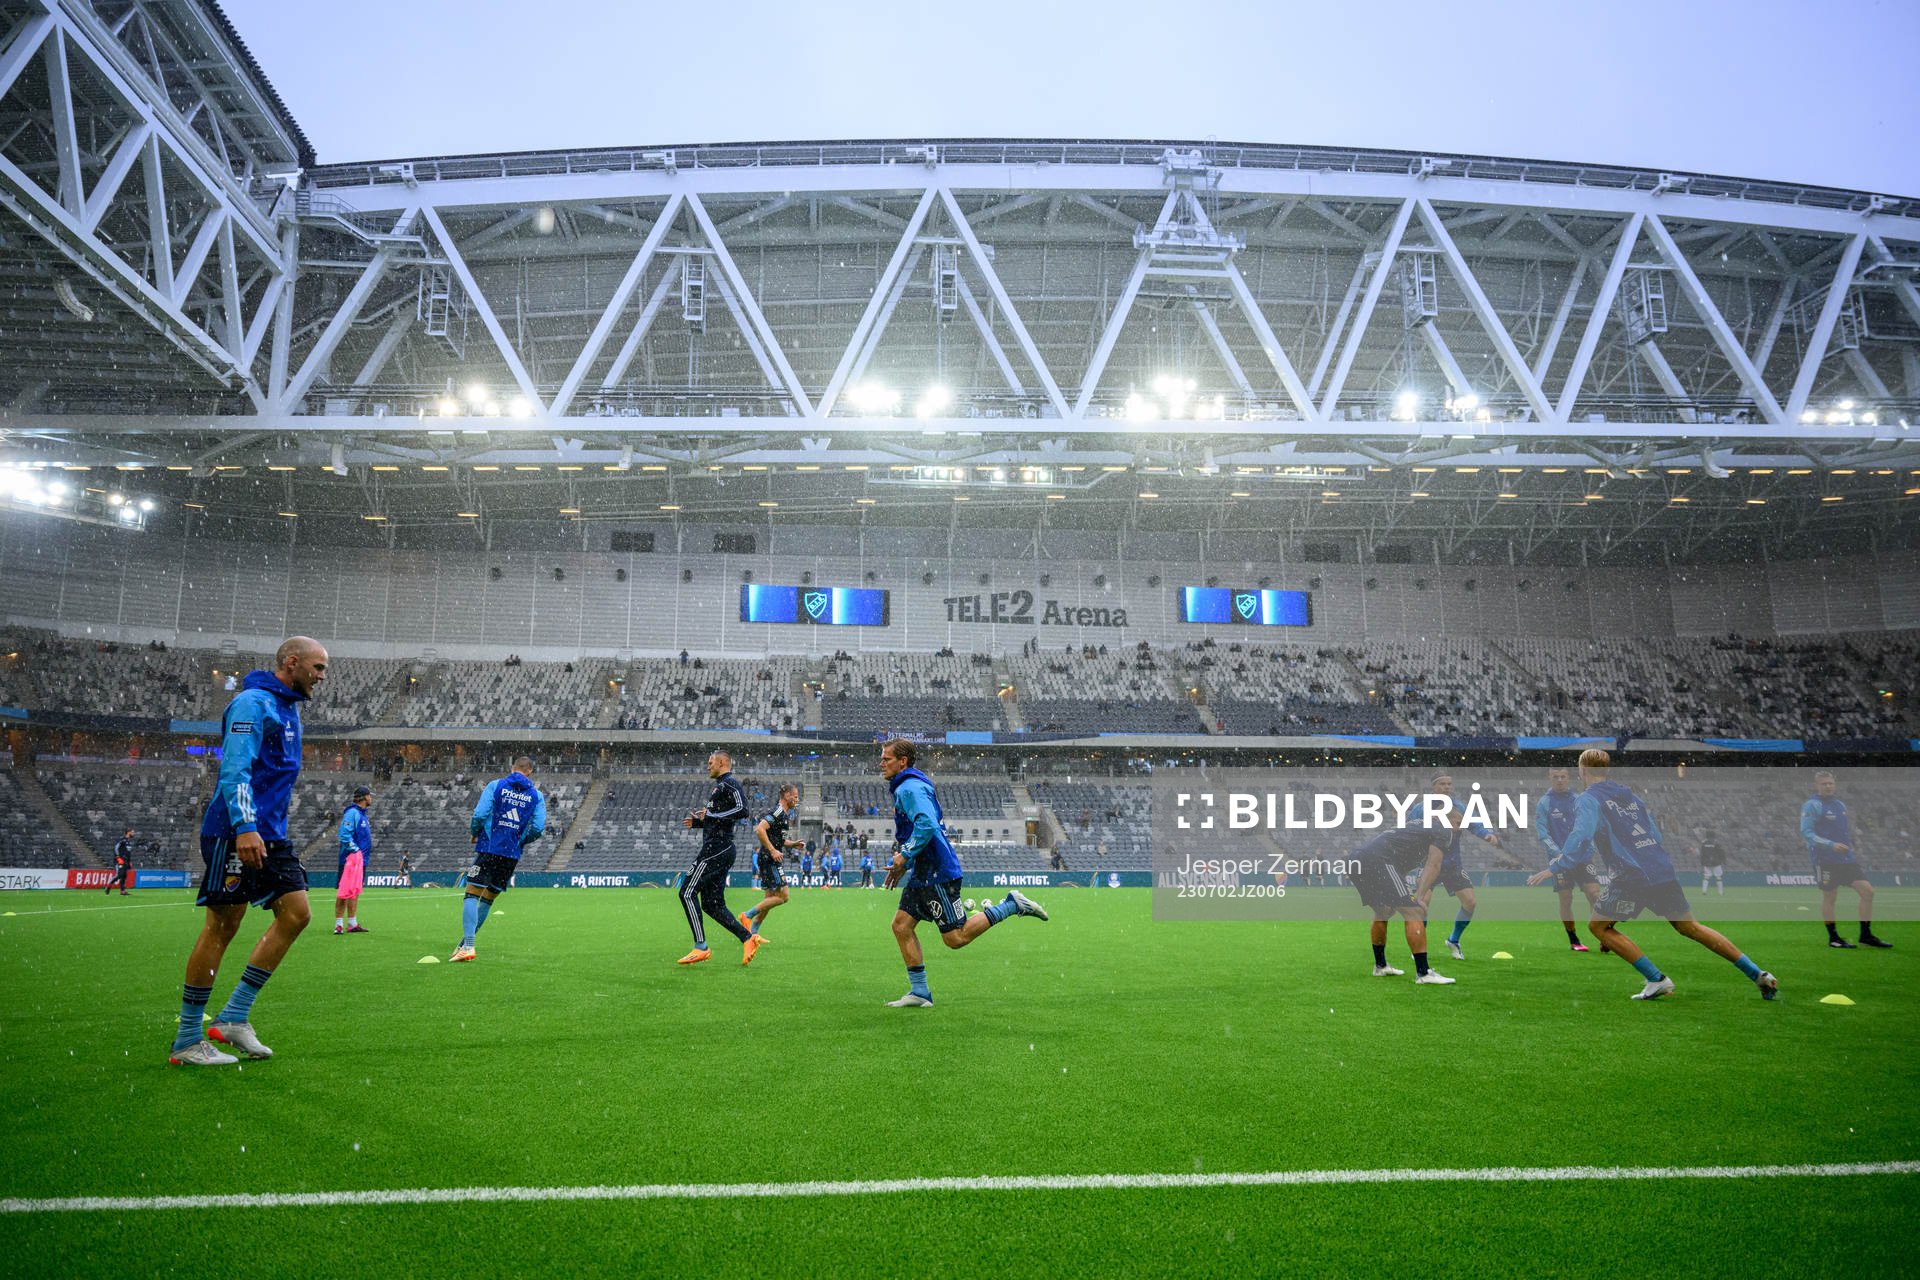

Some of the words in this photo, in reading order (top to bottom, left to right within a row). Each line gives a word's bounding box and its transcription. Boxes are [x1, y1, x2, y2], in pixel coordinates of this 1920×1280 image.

[943, 589, 1035, 625] TELE2
[1040, 600, 1130, 627] Arena
[501, 788, 532, 802] Prioritet
[75, 872, 121, 885] BAUHA
[571, 874, 587, 886] PÅ
[587, 875, 630, 886] RIKTIGT.
[993, 872, 1008, 886] PÅ
[1009, 874, 1050, 886] RIKTIGT.
